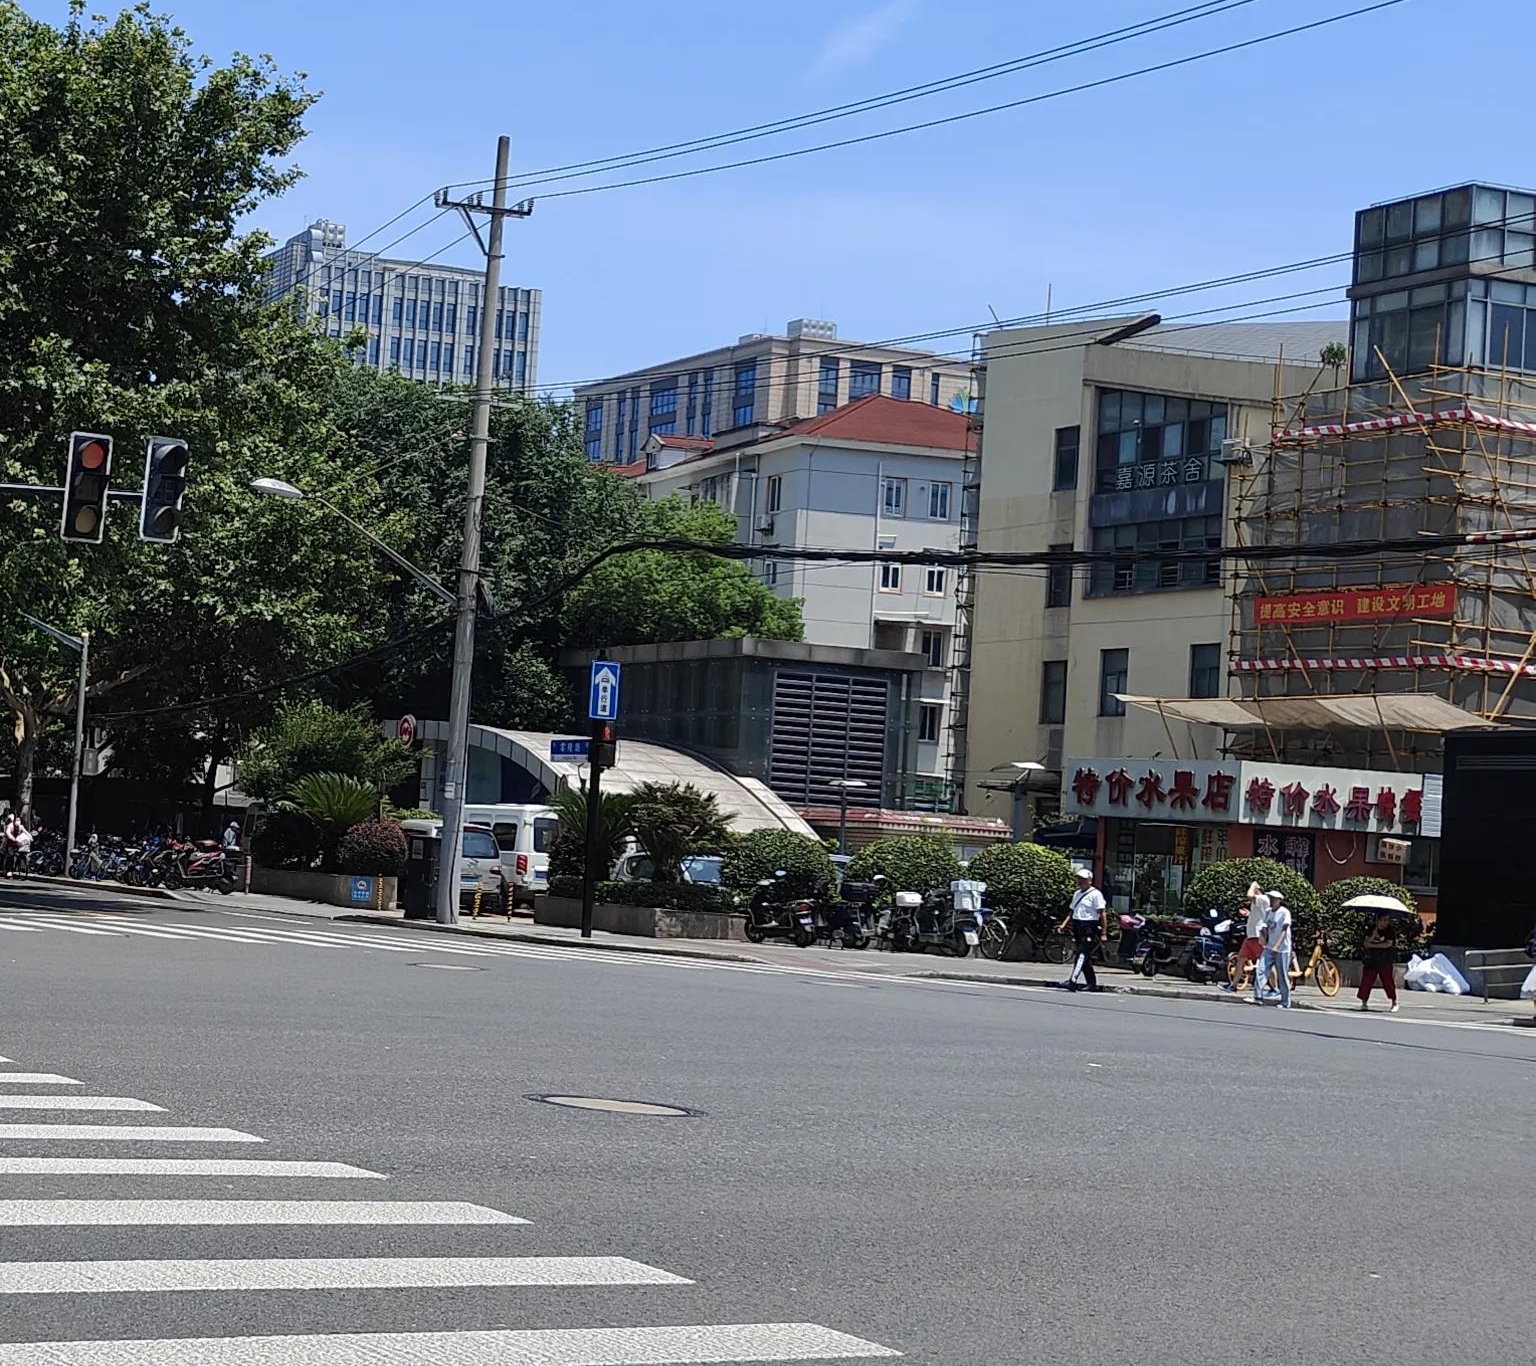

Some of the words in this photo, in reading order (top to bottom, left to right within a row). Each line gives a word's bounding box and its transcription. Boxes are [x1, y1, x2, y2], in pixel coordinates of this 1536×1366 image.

[1116, 457, 1202, 490] 嘉源茶舍
[1259, 599, 1345, 620] 提高安全意识
[1357, 591, 1446, 614] 建设文明工地
[1071, 767, 1237, 811] 特价水果店
